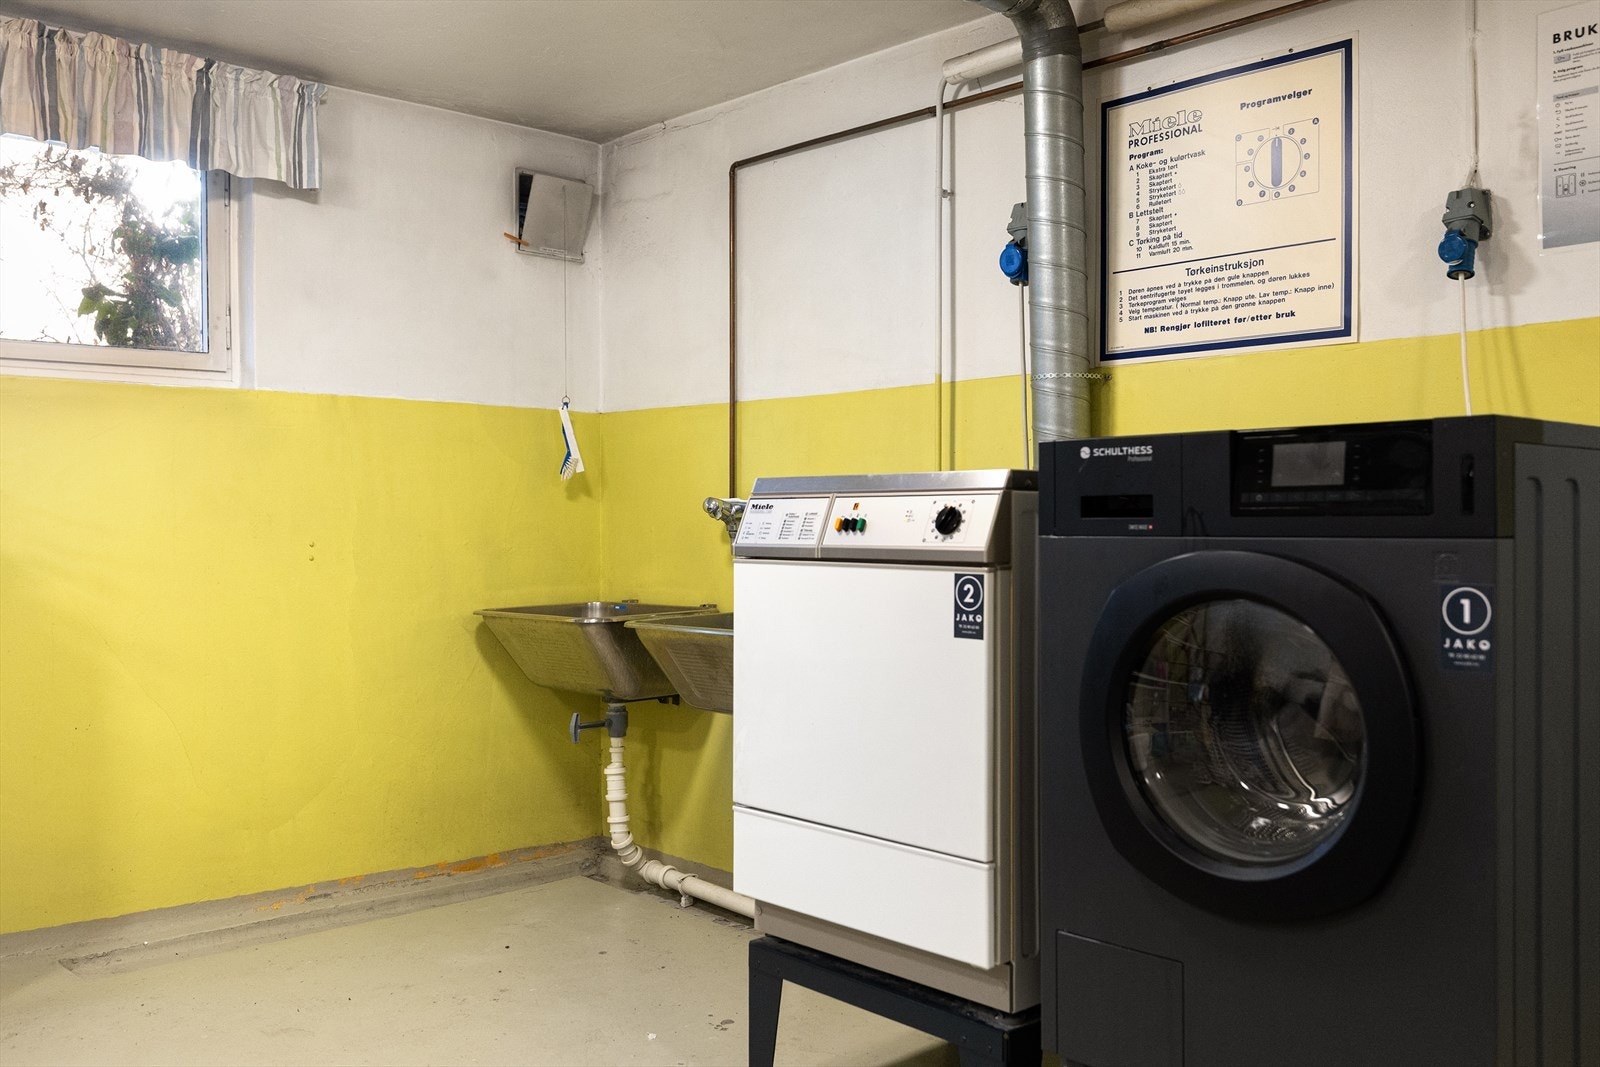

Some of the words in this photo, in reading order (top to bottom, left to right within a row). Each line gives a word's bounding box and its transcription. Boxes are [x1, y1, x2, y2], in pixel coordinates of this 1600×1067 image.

[1553, 23, 1598, 44] BRUK
[1240, 88, 1313, 110] Programvelger
[1129, 110, 1202, 138] Miele
[1128, 124, 1202, 149] PROFESSIONAL
[1129, 149, 1164, 161] Program:
[1136, 161, 1156, 170] Koke-
[1149, 166, 1166, 174] Ekstra
[1185, 259, 1264, 276] Tørkeinstruksjon
[1227, 274, 1240, 282] gule
[1242, 270, 1269, 278] knappen
[1140, 290, 1175, 299] sentrifugerte
[1142, 304, 1173, 313] temperatur.
[1180, 300, 1201, 308] Normal
[1318, 282, 1335, 290] inne)
[1191, 307, 1209, 315] trykke
[1258, 297, 1286, 305] knappen
[1194, 318, 1230, 328] lofilteret
[1276, 310, 1296, 319] bruk
[1093, 445, 1153, 457] SCHULTHESS
[963, 583, 974, 603] 2
[956, 613, 982, 623] JAKO
[1460, 598, 1471, 624] 1
[1443, 637, 1491, 651] JAKO
